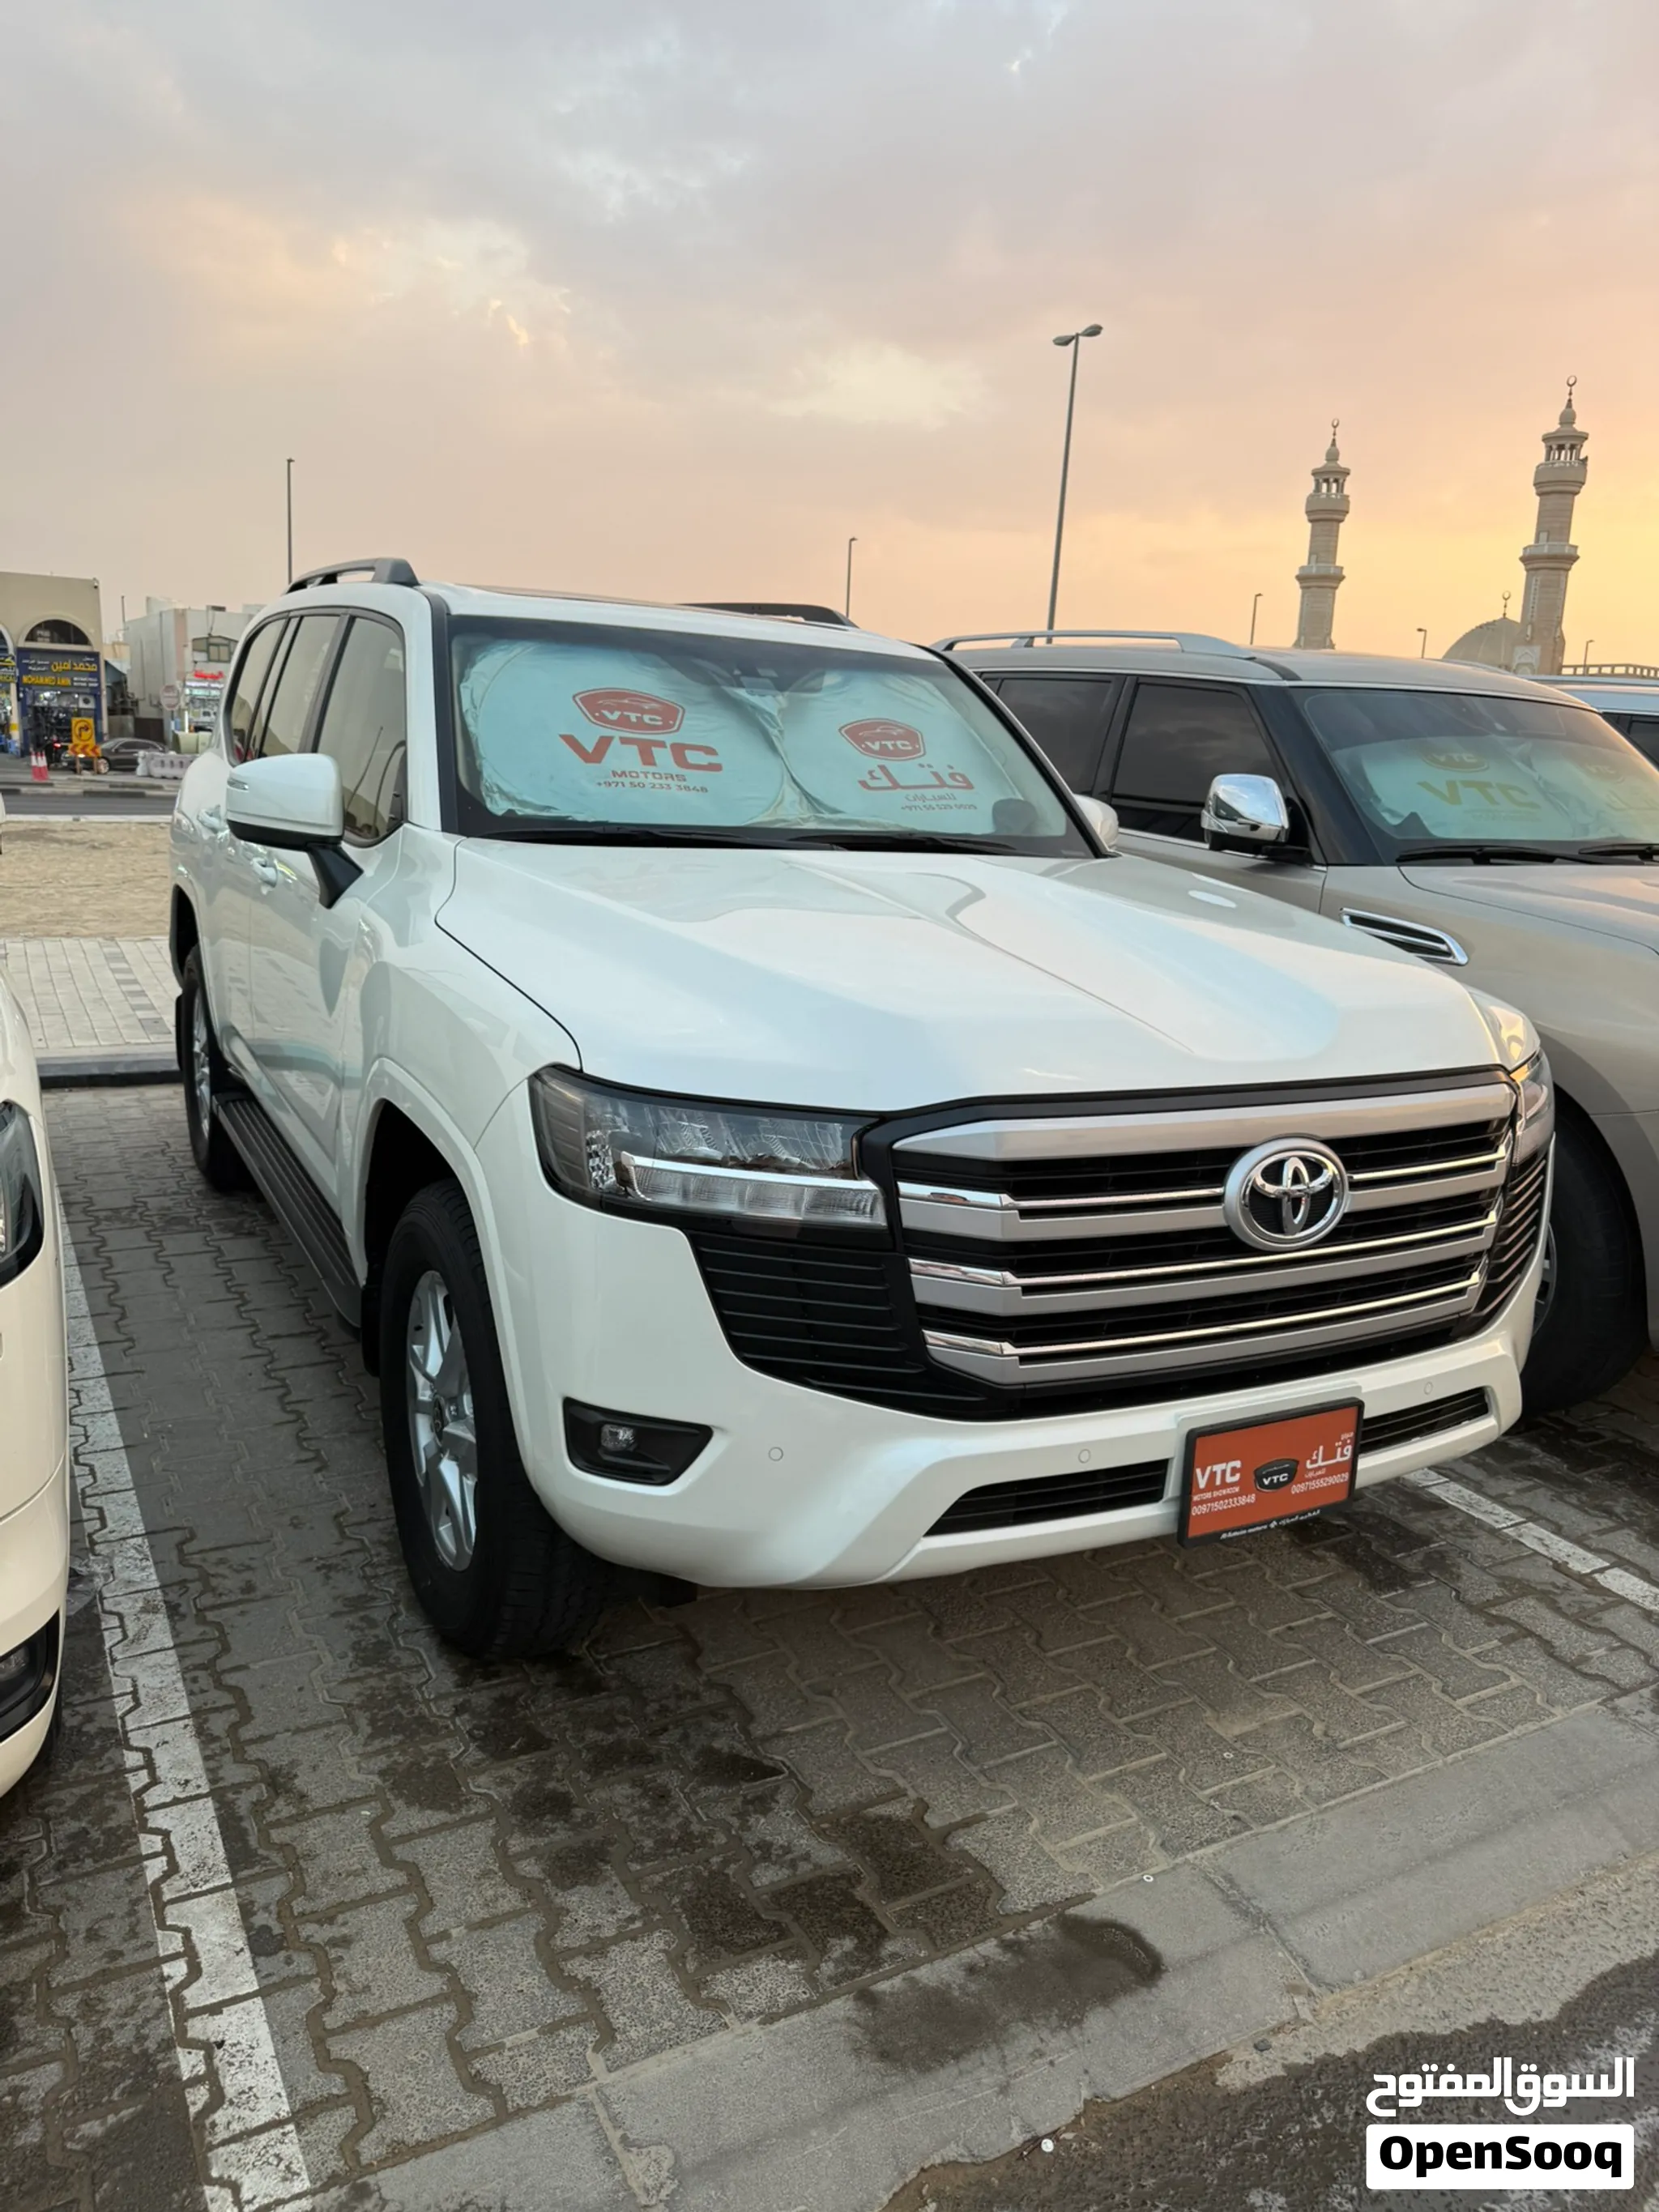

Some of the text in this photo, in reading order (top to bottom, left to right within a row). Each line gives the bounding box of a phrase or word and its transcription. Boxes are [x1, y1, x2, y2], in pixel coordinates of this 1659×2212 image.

[72, 661, 98, 671] محمد
[601, 710, 663, 725] VTC
[864, 740, 912, 752] VTC
[559, 734, 723, 772] VTC
[1432, 752, 1478, 762] VTC
[612, 770, 687, 782] MOTORS
[858, 763, 975, 791] فتك
[649, 782, 672, 791] 233
[676, 785, 708, 793] 3848
[1416, 780, 1542, 809] VTC
[1306, 1439, 1352, 1469] فتك
[1196, 1460, 1242, 1489] VTC
[1262, 1473, 1288, 1485] VTC
